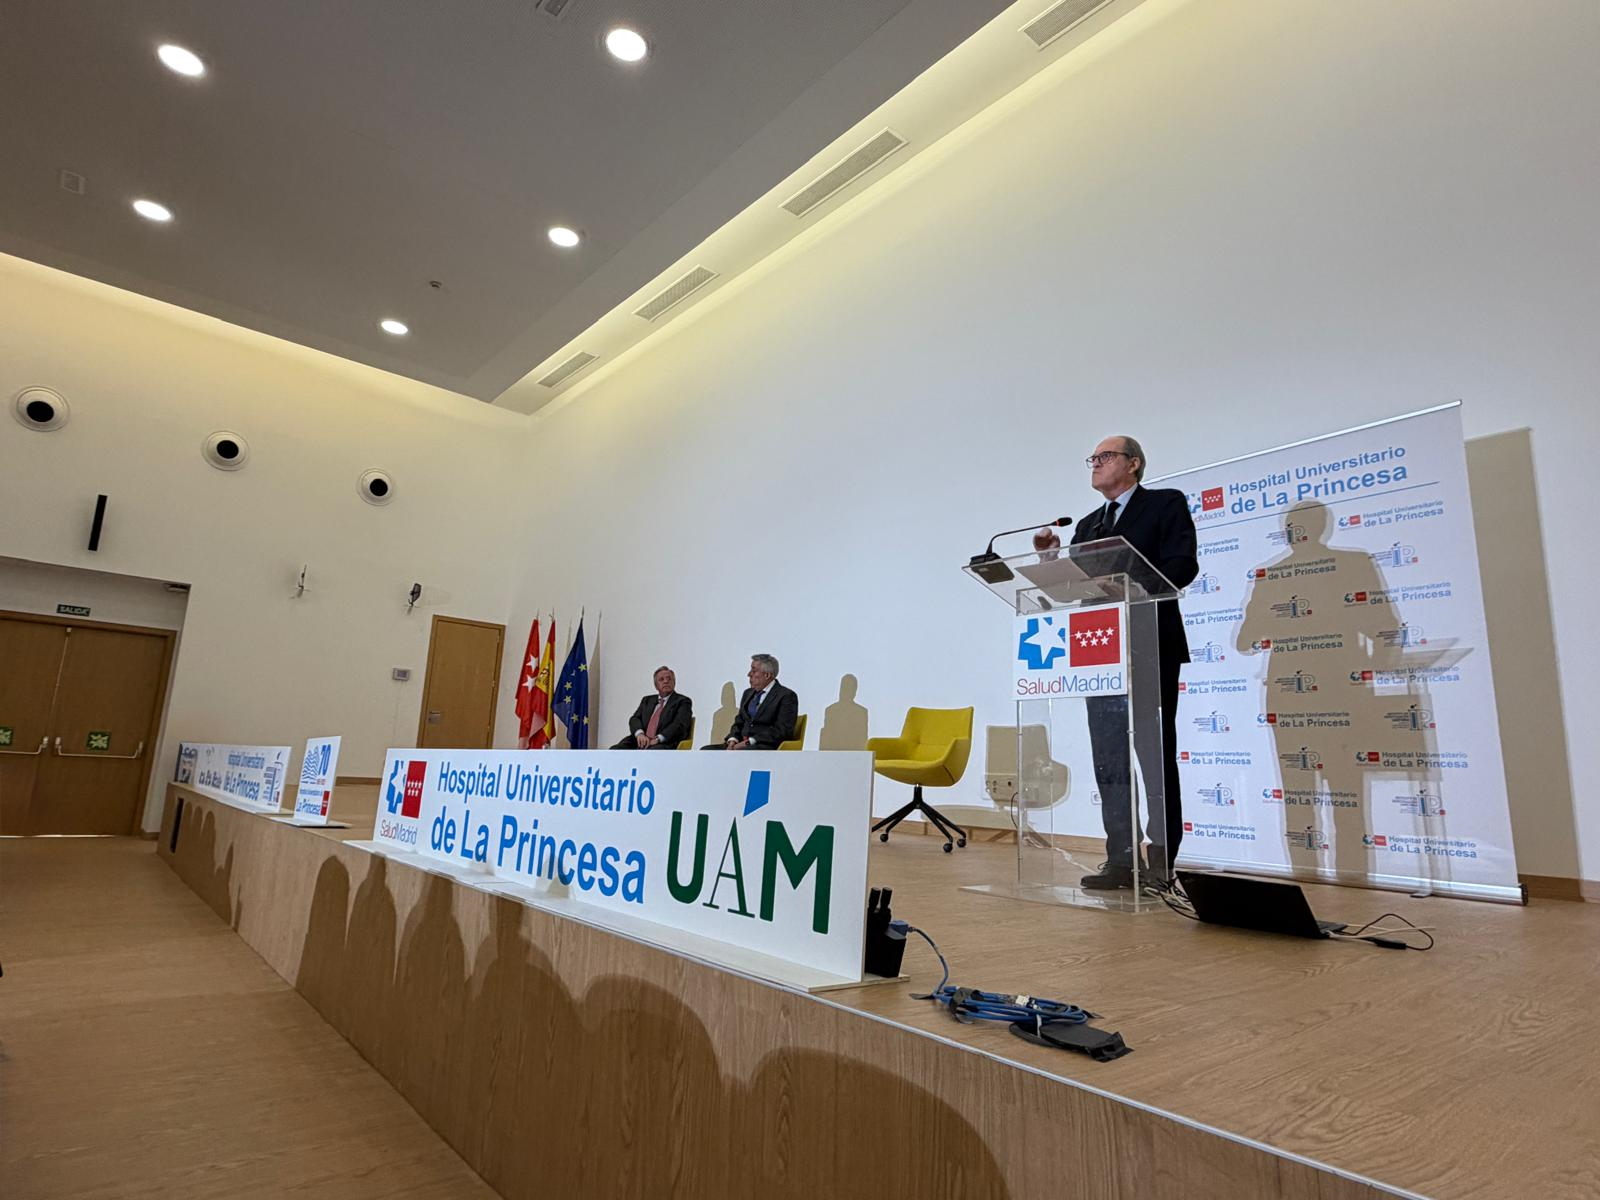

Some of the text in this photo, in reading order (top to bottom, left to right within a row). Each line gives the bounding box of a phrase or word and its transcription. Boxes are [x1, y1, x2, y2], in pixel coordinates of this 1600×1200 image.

[1229, 447, 1405, 496] Hospital Universitario
[1231, 465, 1407, 514] de La Princesa
[1363, 500, 1443, 519] Hospital Universitario
[1364, 508, 1444, 528] de La Princesa
[1204, 544, 1239, 555] Princesa
[1268, 565, 1336, 580] de La Princesa
[1370, 596, 1384, 605] de
[1385, 594, 1399, 602] La
[1402, 589, 1452, 601] Princesa
[1185, 613, 1243, 626] de La Princesa
[1300, 634, 1343, 642] Universitario
[1273, 645, 1285, 653] de
[1286, 644, 1298, 652] La
[1301, 641, 1343, 651] Princesa
[1017, 672, 1122, 696] SaludMadrid
[1376, 676, 1390, 685] de
[1392, 676, 1406, 684] La
[1409, 673, 1460, 682] Princesa
[1211, 685, 1247, 693] Princesa
[1293, 720, 1304, 728] La
[1307, 719, 1350, 727] Princesa
[318, 744, 332, 776] 70
[1202, 757, 1213, 765] La
[1383, 759, 1397, 767] de
[1400, 759, 1413, 767] La
[1417, 759, 1469, 769] Princesa
[437, 761, 655, 815] Hospital Universitario
[1285, 797, 1358, 808] de La Princesa
[1194, 829, 1204, 837] de
[1206, 830, 1217, 838] La
[1219, 831, 1256, 840] Princesa
[1388, 836, 1477, 848] Hospital Universitario
[431, 805, 646, 904] de La Princesa
[1390, 843, 1404, 853] de
[1407, 844, 1421, 854] La
[1424, 845, 1477, 859] Princesa
